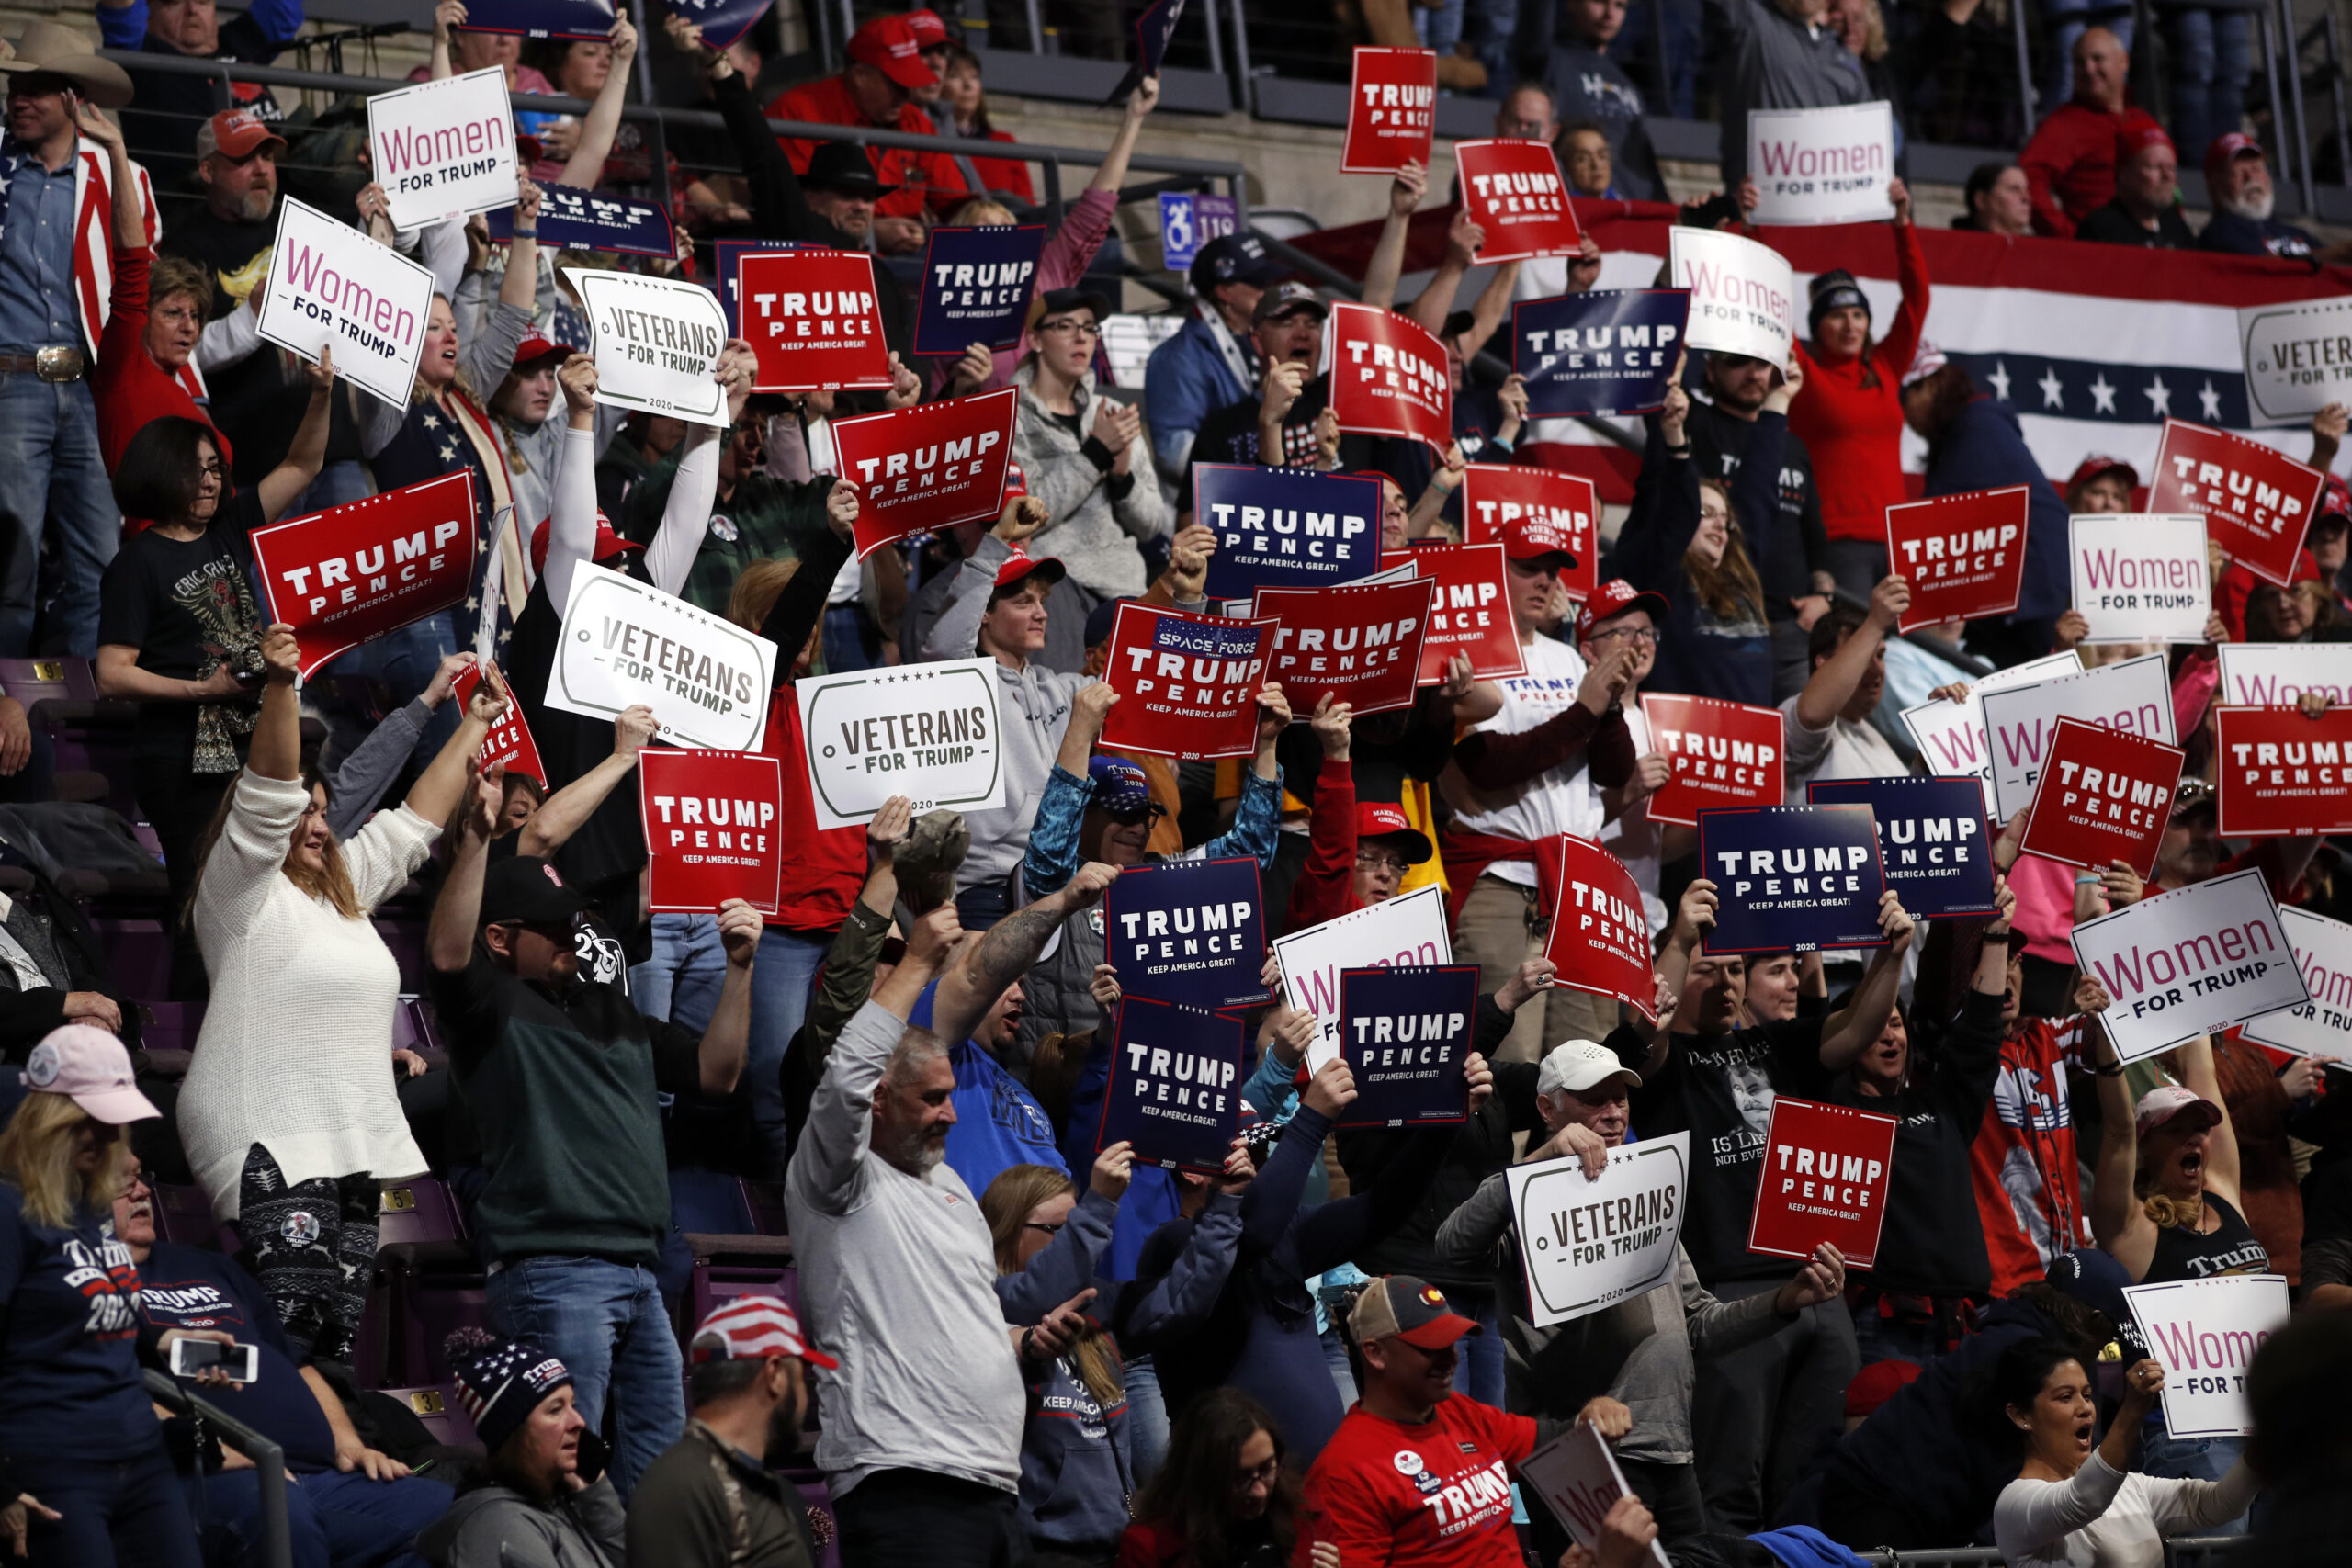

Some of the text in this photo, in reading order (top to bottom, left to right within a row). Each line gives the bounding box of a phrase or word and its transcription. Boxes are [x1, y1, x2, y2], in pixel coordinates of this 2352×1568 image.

[1363, 84, 1433, 107] TRUMP
[1371, 110, 1430, 126] PENCE
[381, 117, 503, 175] Women
[1761, 141, 1883, 177] Women
[401, 158, 497, 194] FOR TRUMP
[1472, 172, 1559, 197] TRUMP
[1776, 177, 1875, 196] FOR TRUMP
[1487, 197, 1561, 214] PENCE
[935, 261, 1034, 287] TRUMP
[288, 237, 414, 346] Women
[754, 291, 873, 317] TRUMP
[941, 288, 1022, 306] PENCE
[1685, 259, 1791, 328] Women
[293, 296, 396, 359] FOR TRUMP
[609, 307, 718, 358] VETERANS
[769, 320, 872, 337] PENCE
[1704, 304, 1786, 341] FOR TRUMP
[781, 342, 805, 351] KEEP
[807, 341, 842, 350] AMERICA
[1527, 324, 1677, 352] TRUMP
[628, 344, 707, 377] FOR TRUMP
[1346, 340, 1447, 392] TRUMP
[1541, 351, 1664, 369] PENCE
[1360, 367, 1443, 411] PENCE
[2291, 369, 2324, 386] FOR
[650, 398, 673, 411] 2020
[856, 430, 1001, 483] TRUMP
[870, 459, 984, 500] PENCE
[2173, 455, 2302, 517] TRUMP
[877, 480, 970, 509] KEEP AMERICA GREAT!
[1211, 503, 1366, 539] TRUMP
[2181, 482, 2285, 534] PENCE
[907, 527, 926, 536] 2020
[1901, 524, 2018, 563] TRUMP
[283, 520, 459, 596] TRUMP
[1225, 533, 1351, 559] PENCE
[1235, 555, 1339, 572] KEEP AMERICA GREAT!
[1916, 552, 2005, 581] PENCE
[2083, 549, 2201, 590] Women
[175, 570, 206, 596] ERIC
[310, 554, 445, 615] PENCE
[323, 578, 433, 623] KEEP AMERICA GREAT!
[2102, 595, 2195, 610] FOR TRUMP
[1159, 633, 1257, 655] SPACE FORCE
[1274, 617, 1417, 652] TRUMP
[1457, 632, 1485, 641] GREAT!
[45, 663, 53, 679] 9
[603, 615, 752, 704] VETERANS
[1126, 647, 1262, 684] TRUMP
[1279, 647, 1401, 671] PENCE
[613, 657, 733, 716] FOR TRUMP
[1290, 668, 1388, 684] KEEP AMERICA GREAT!
[1136, 679, 1249, 705] PENCE
[1146, 702, 1238, 718] KEEP AMERICA GREAT!
[841, 706, 986, 756] VETERANS
[865, 746, 974, 774] FOR TRUMP
[1661, 729, 1775, 768] TRUMP
[1107, 764, 1147, 779] Trump
[1125, 779, 1145, 788] 2020
[1676, 757, 1765, 786] PENCE
[2060, 760, 2169, 809] TRUMP
[1682, 778, 1699, 788] KEEP
[1700, 782, 1730, 794] AMERICA
[2256, 789, 2278, 797] KEEP
[2280, 788, 2317, 796] AMERICA
[654, 795, 775, 829] TRUMP
[2063, 792, 2155, 829] PENCE
[2068, 814, 2089, 826] KEEP
[2090, 820, 2123, 835] AMERICA
[671, 829, 766, 852] PENCE
[683, 854, 760, 867] KEEP AMERICA GREAT!
[1718, 846, 1868, 875] TRUMP
[1928, 868, 1960, 877] GREAT!
[1736, 876, 1860, 897] PENCE
[1572, 880, 1645, 940] TRUMP
[1748, 897, 1850, 910] KEEP AMERICA GREAT!
[1121, 901, 1252, 940] TRUMP
[1136, 933, 1243, 961] PENCE
[1580, 914, 1645, 960] PENCE
[1589, 939, 1606, 950] KEEP
[1607, 944, 1629, 961] AMERICA
[1795, 942, 1815, 952] 2020
[1148, 958, 1236, 975] KEEP AMERICA GREAT!
[2094, 919, 2275, 1001] Women
[2132, 987, 2183, 1019] FOR
[2188, 962, 2267, 997] TRUMP
[1352, 1012, 1465, 1043] TRUMP
[2207, 1021, 2229, 1032] 2020
[1126, 1043, 1235, 1089] TRUMP
[1363, 1045, 1451, 1067] PENCE
[1368, 1069, 1440, 1082] KEEP AMERICA GREAT!
[1135, 1078, 1226, 1113] PENCE
[1142, 1105, 1217, 1128] KEEP AMERICA GREAT!
[1711, 1136, 1732, 1154] IS
[1715, 1155, 1737, 1166] NOT
[1777, 1144, 1882, 1185] TRUMP
[394, 1192, 403, 1208] 5
[1781, 1178, 1871, 1208] PENCE
[1551, 1184, 1676, 1247] VETERANS
[1788, 1202, 1860, 1221] KEEP AMERICA GREAT!
[1573, 1226, 1662, 1267] FOR TRUMP
[1601, 1288, 1623, 1303] 2020
[2188, 1376, 2229, 1395] FOR
[423, 1394, 431, 1411] 3
[1043, 1396, 1072, 1408] KEEP
[1422, 1460, 1510, 1525] TRUMP
[1440, 1520, 1467, 1538] KEEP
